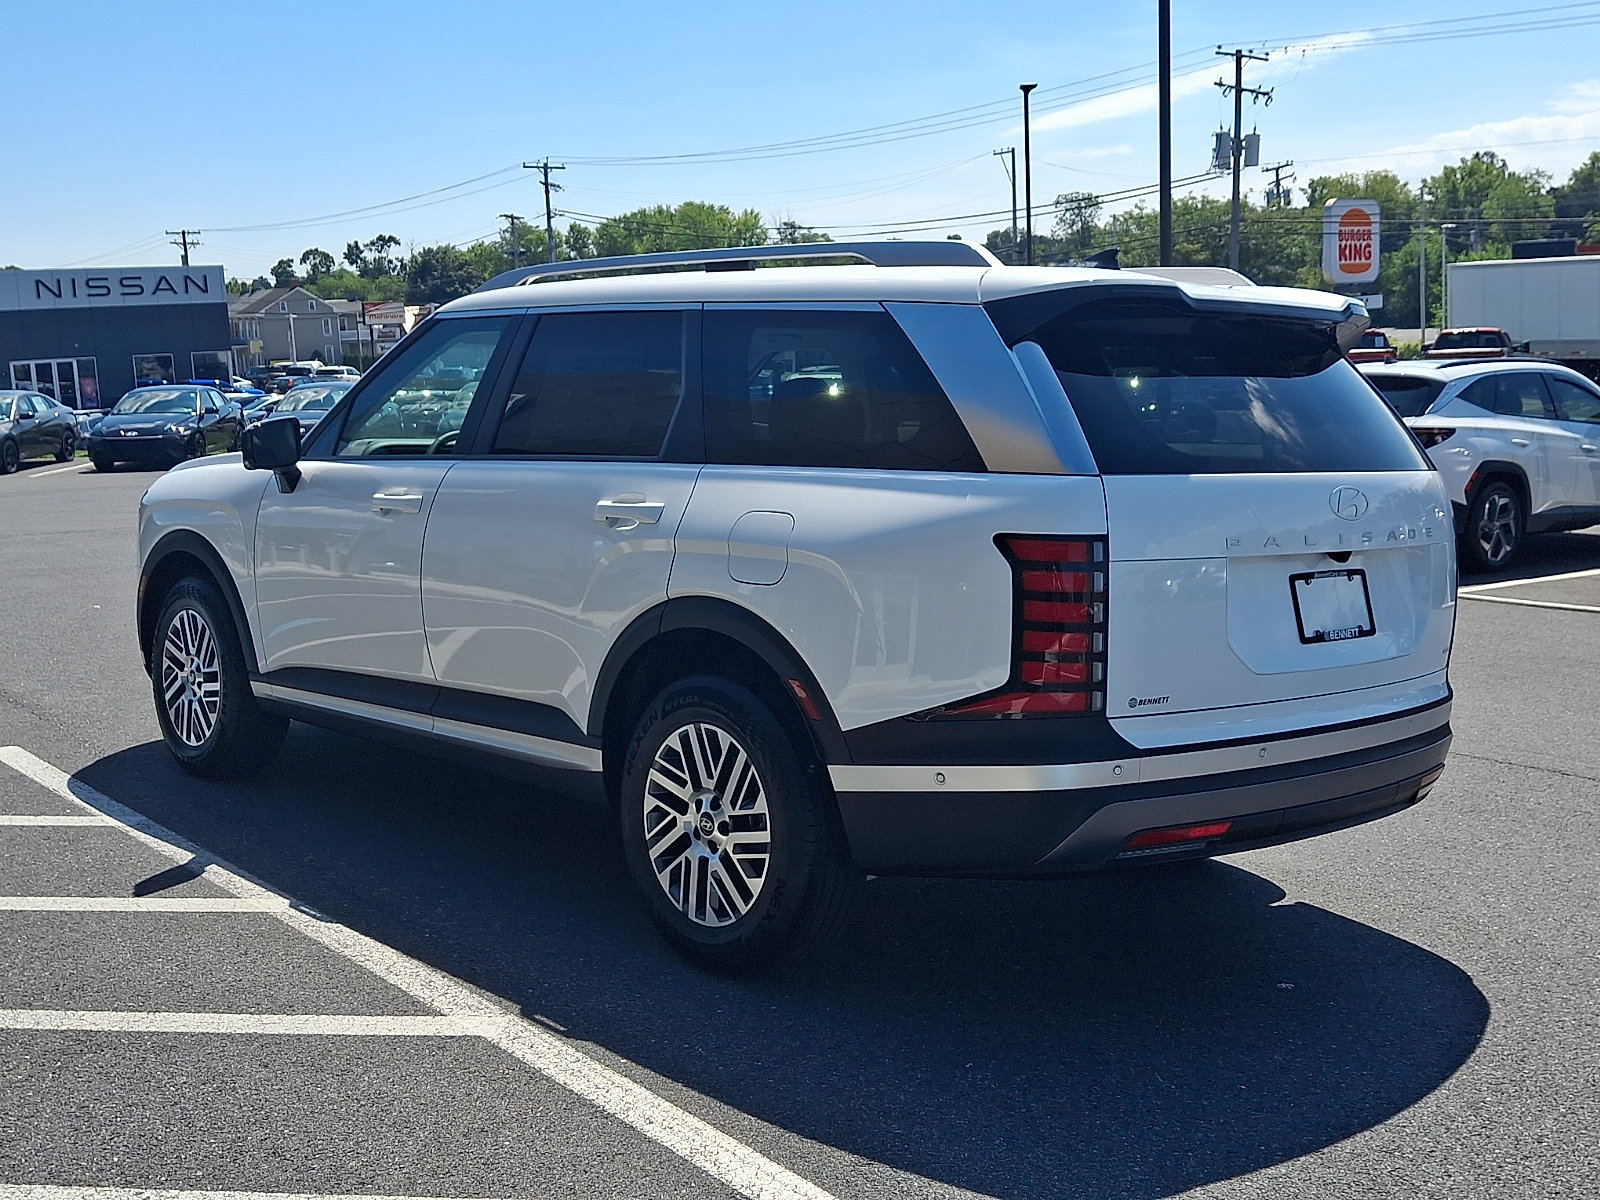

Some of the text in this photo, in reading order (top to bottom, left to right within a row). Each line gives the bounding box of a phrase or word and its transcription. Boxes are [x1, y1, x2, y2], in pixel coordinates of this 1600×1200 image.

[1338, 229, 1373, 242] BURGER
[1338, 243, 1372, 262] KING
[35, 274, 210, 299] NISSAN
[1225, 526, 1434, 550] PALISADE
[1329, 628, 1359, 640] BENNETT
[1138, 696, 1170, 706] BENNETT
